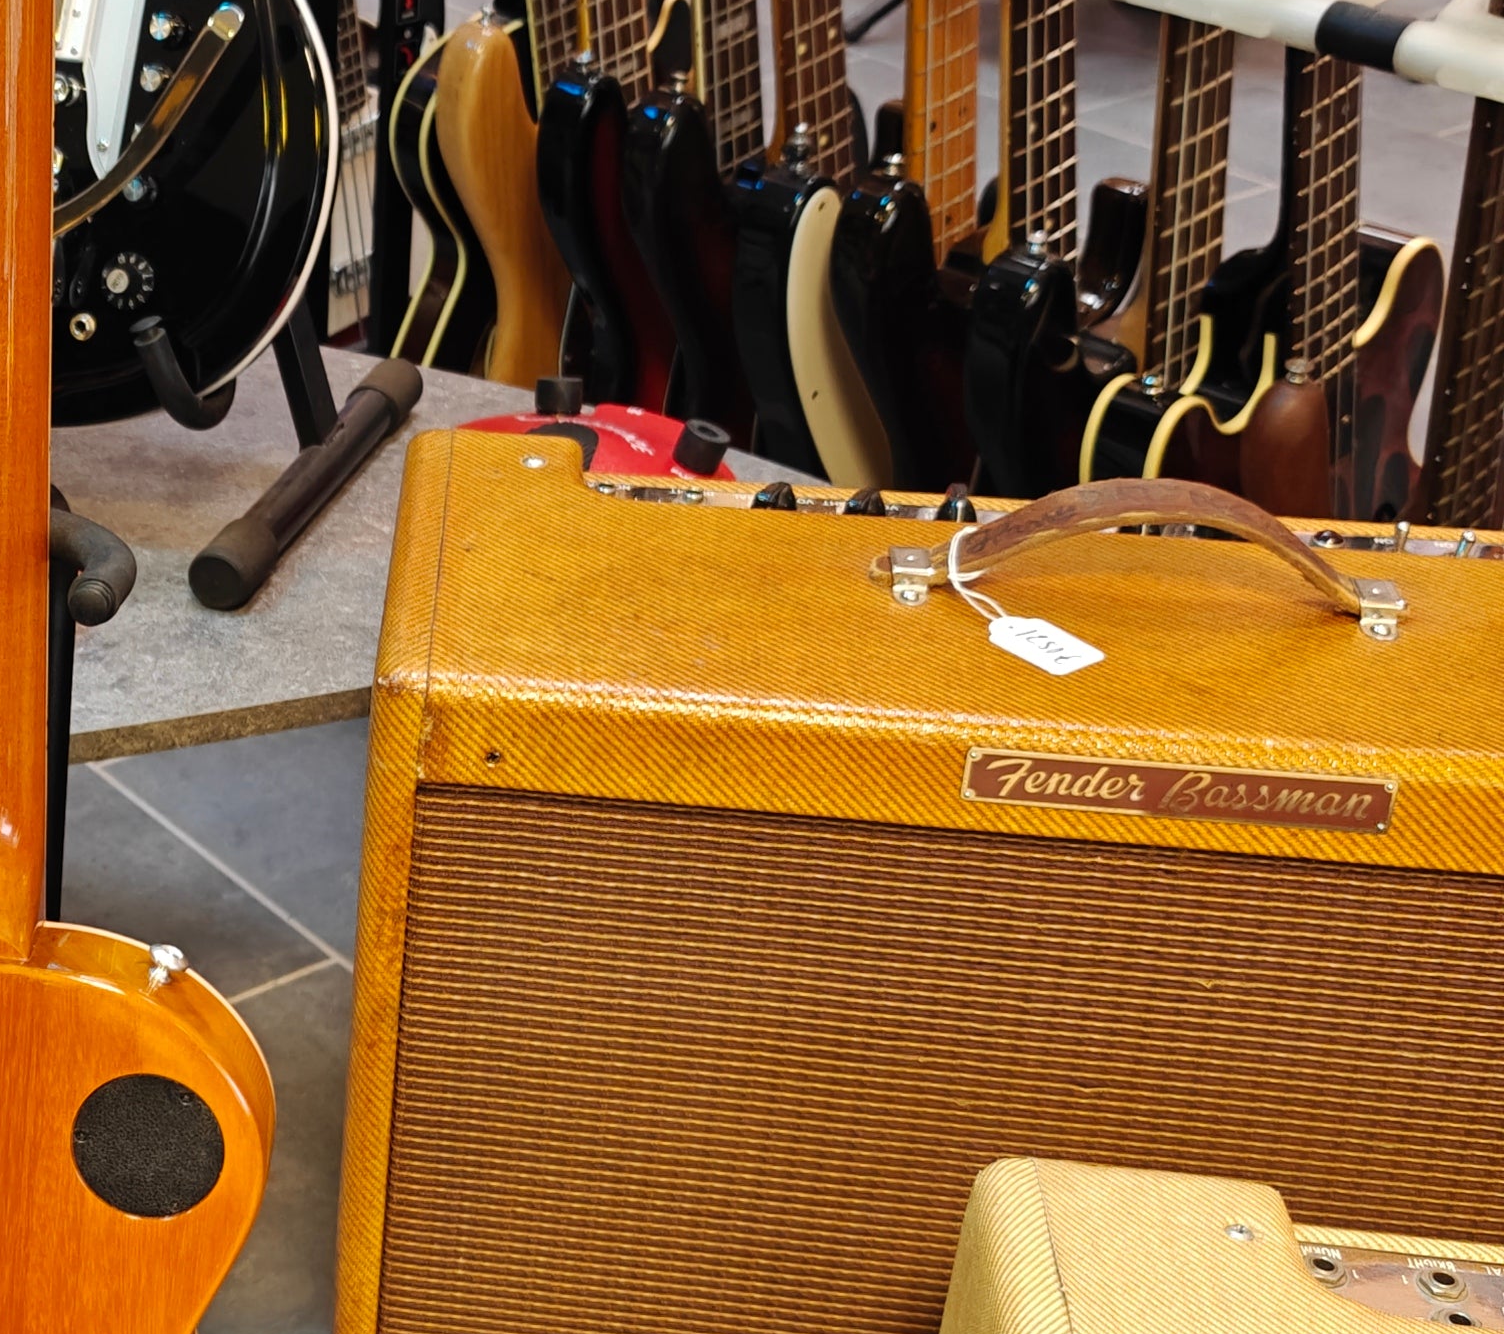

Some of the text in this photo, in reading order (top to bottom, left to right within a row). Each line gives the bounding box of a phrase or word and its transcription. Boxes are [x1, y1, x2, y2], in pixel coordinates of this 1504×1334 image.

[986, 758, 1373, 821] Fender Bassman
[1406, 1258, 1457, 1273] BRIGHT
